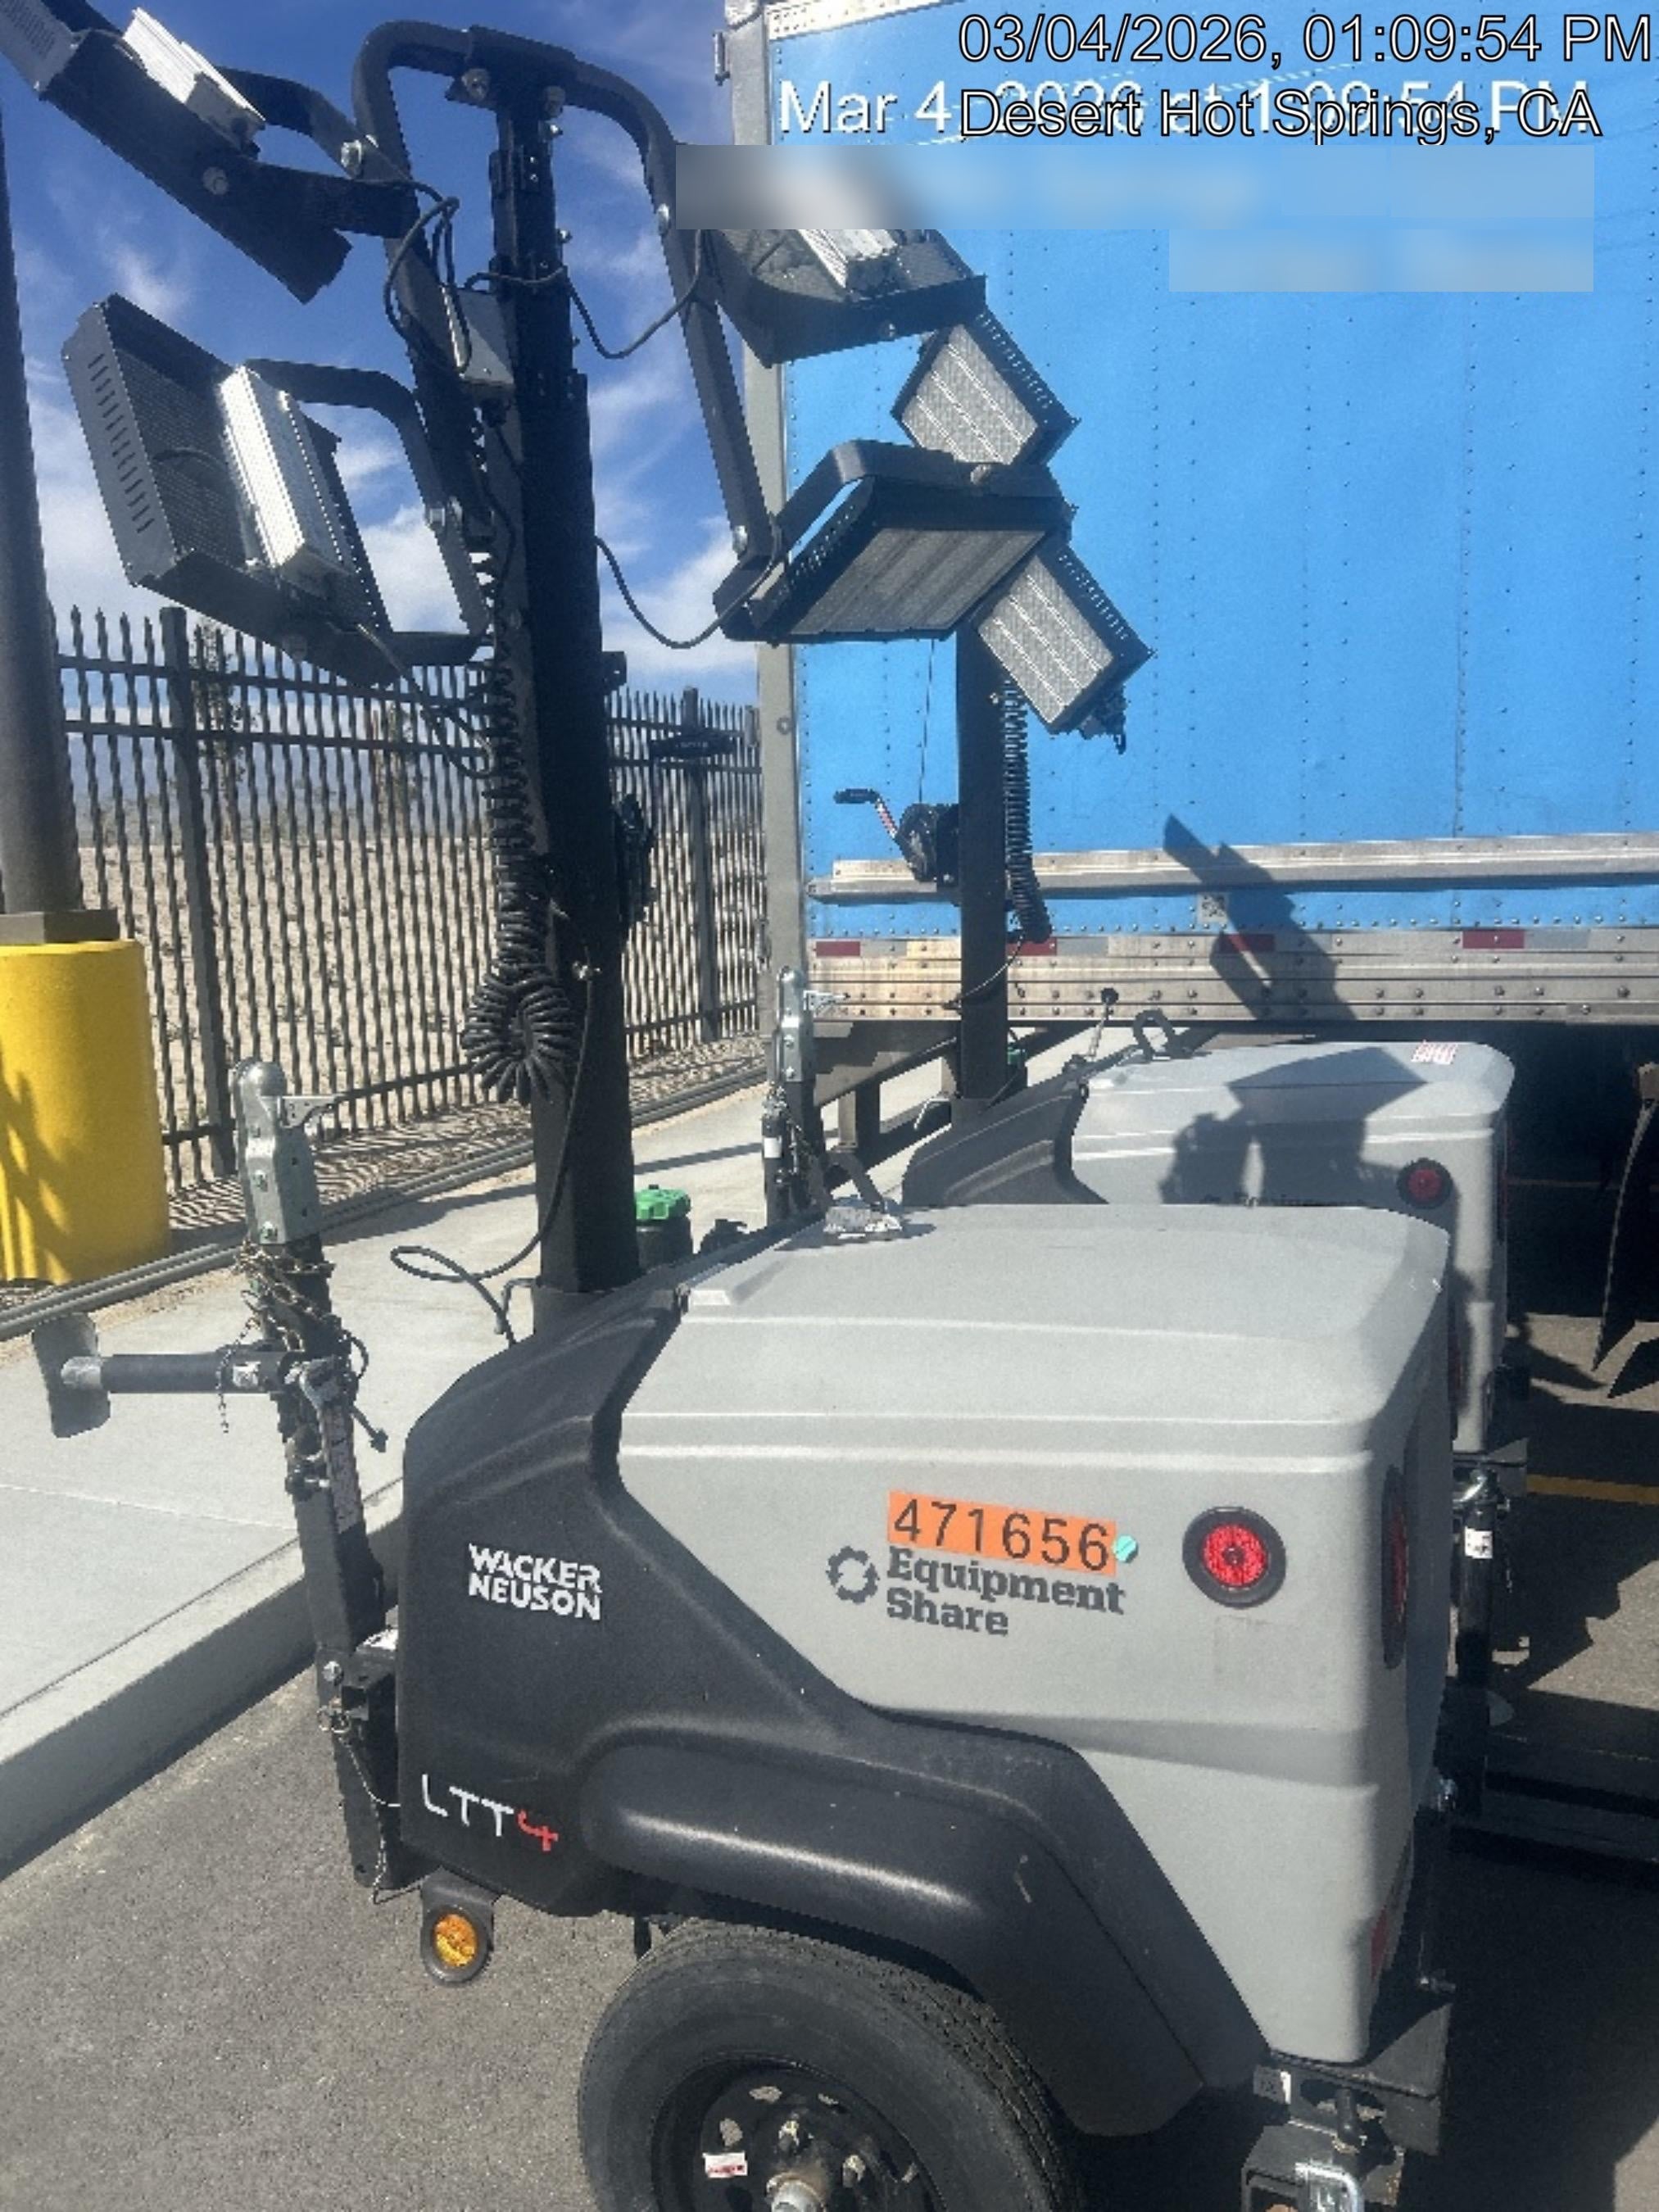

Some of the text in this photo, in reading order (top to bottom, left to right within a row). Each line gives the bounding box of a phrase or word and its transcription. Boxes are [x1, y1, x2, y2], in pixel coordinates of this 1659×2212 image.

[893, 1498, 1110, 1572] 471656
[469, 1543, 603, 1593] WACKER
[469, 1572, 601, 1621] NEUSON
[886, 1545, 1126, 1616] Equipment
[886, 1586, 1009, 1637] Share
[421, 1773, 560, 1852] LTT4
